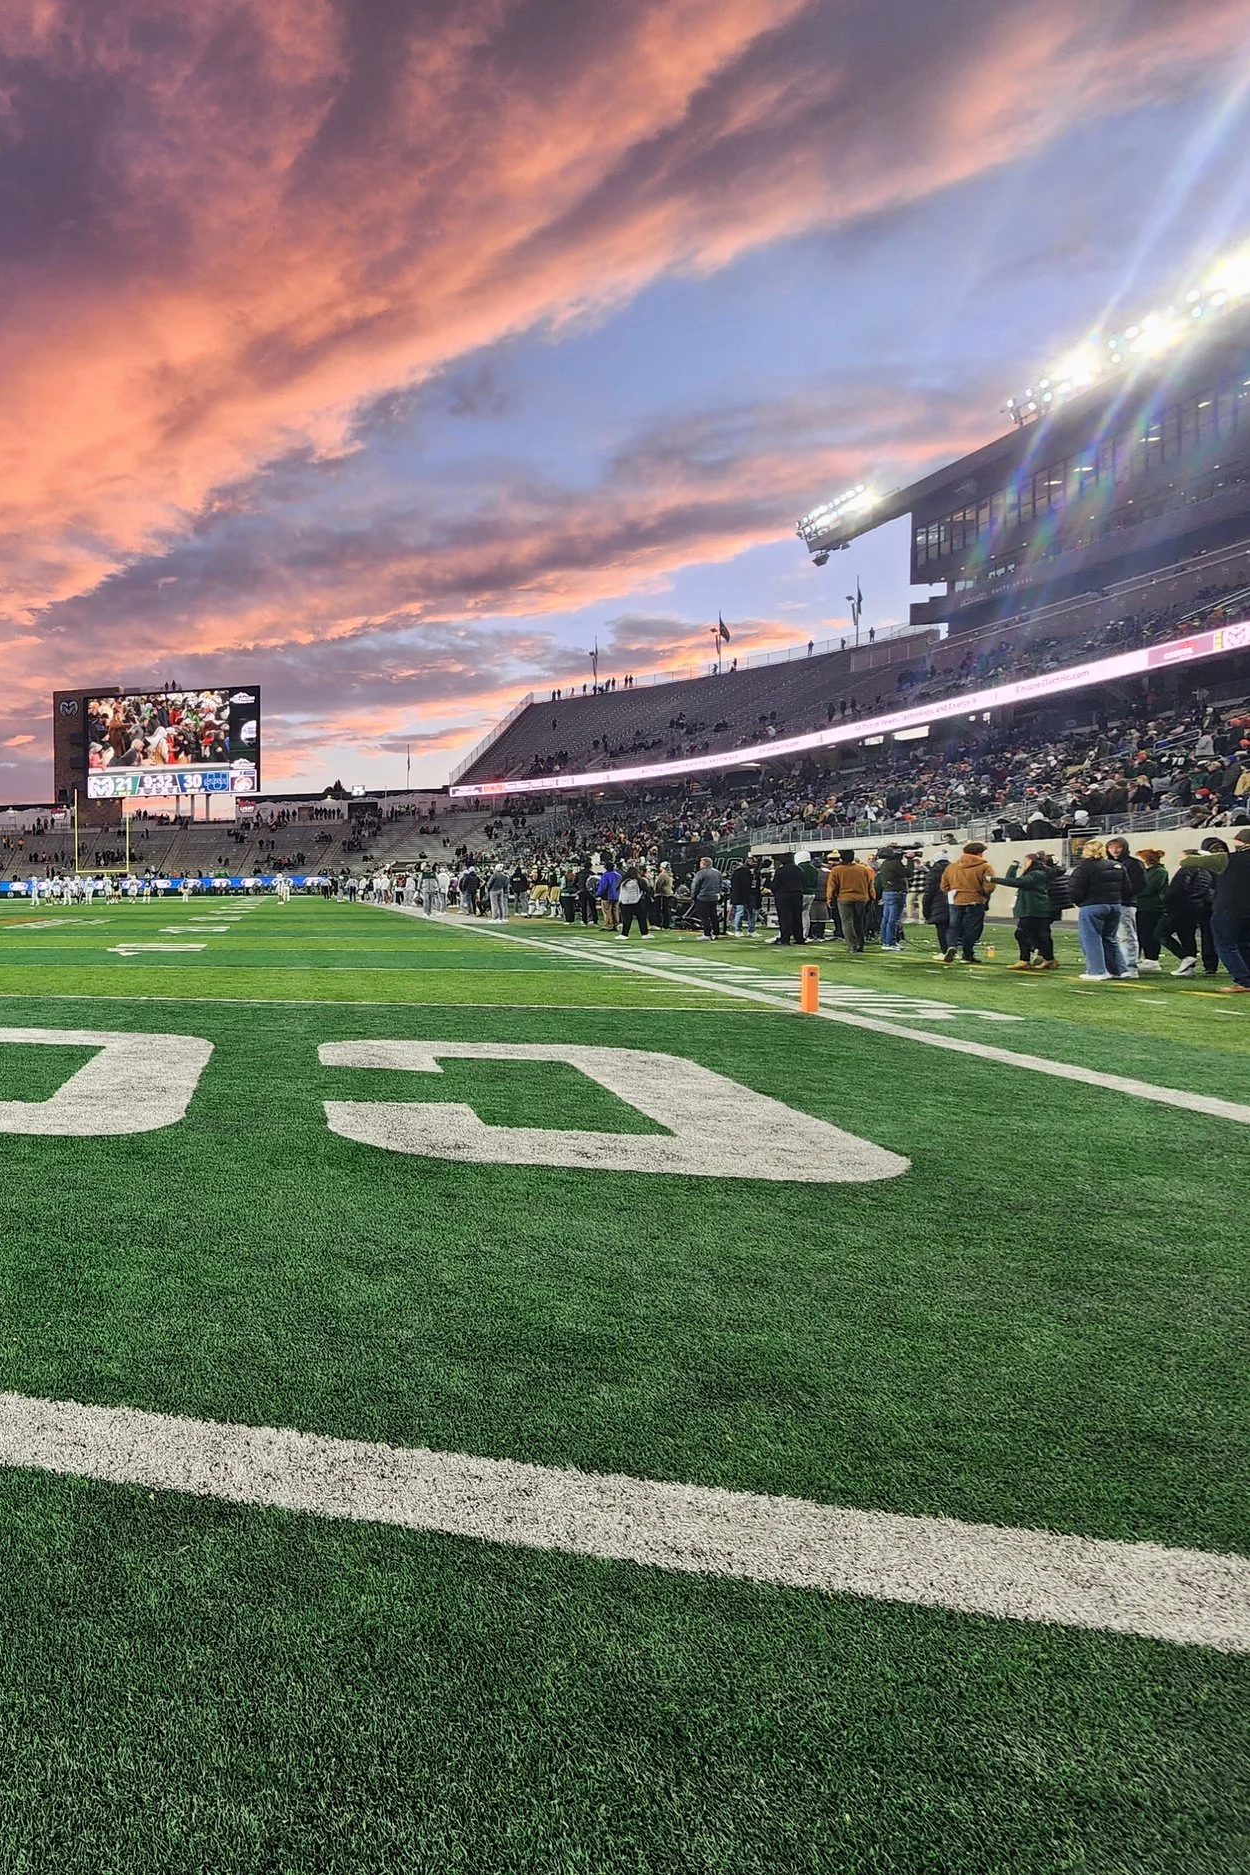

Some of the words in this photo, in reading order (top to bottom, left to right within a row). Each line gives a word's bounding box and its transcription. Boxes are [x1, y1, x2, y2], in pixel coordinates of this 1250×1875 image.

[1015, 669, 1090, 695] EncoreElectric.com
[115, 777, 133, 791] 21
[143, 775, 173, 789] 9:32
[183, 774, 202, 788] 30
